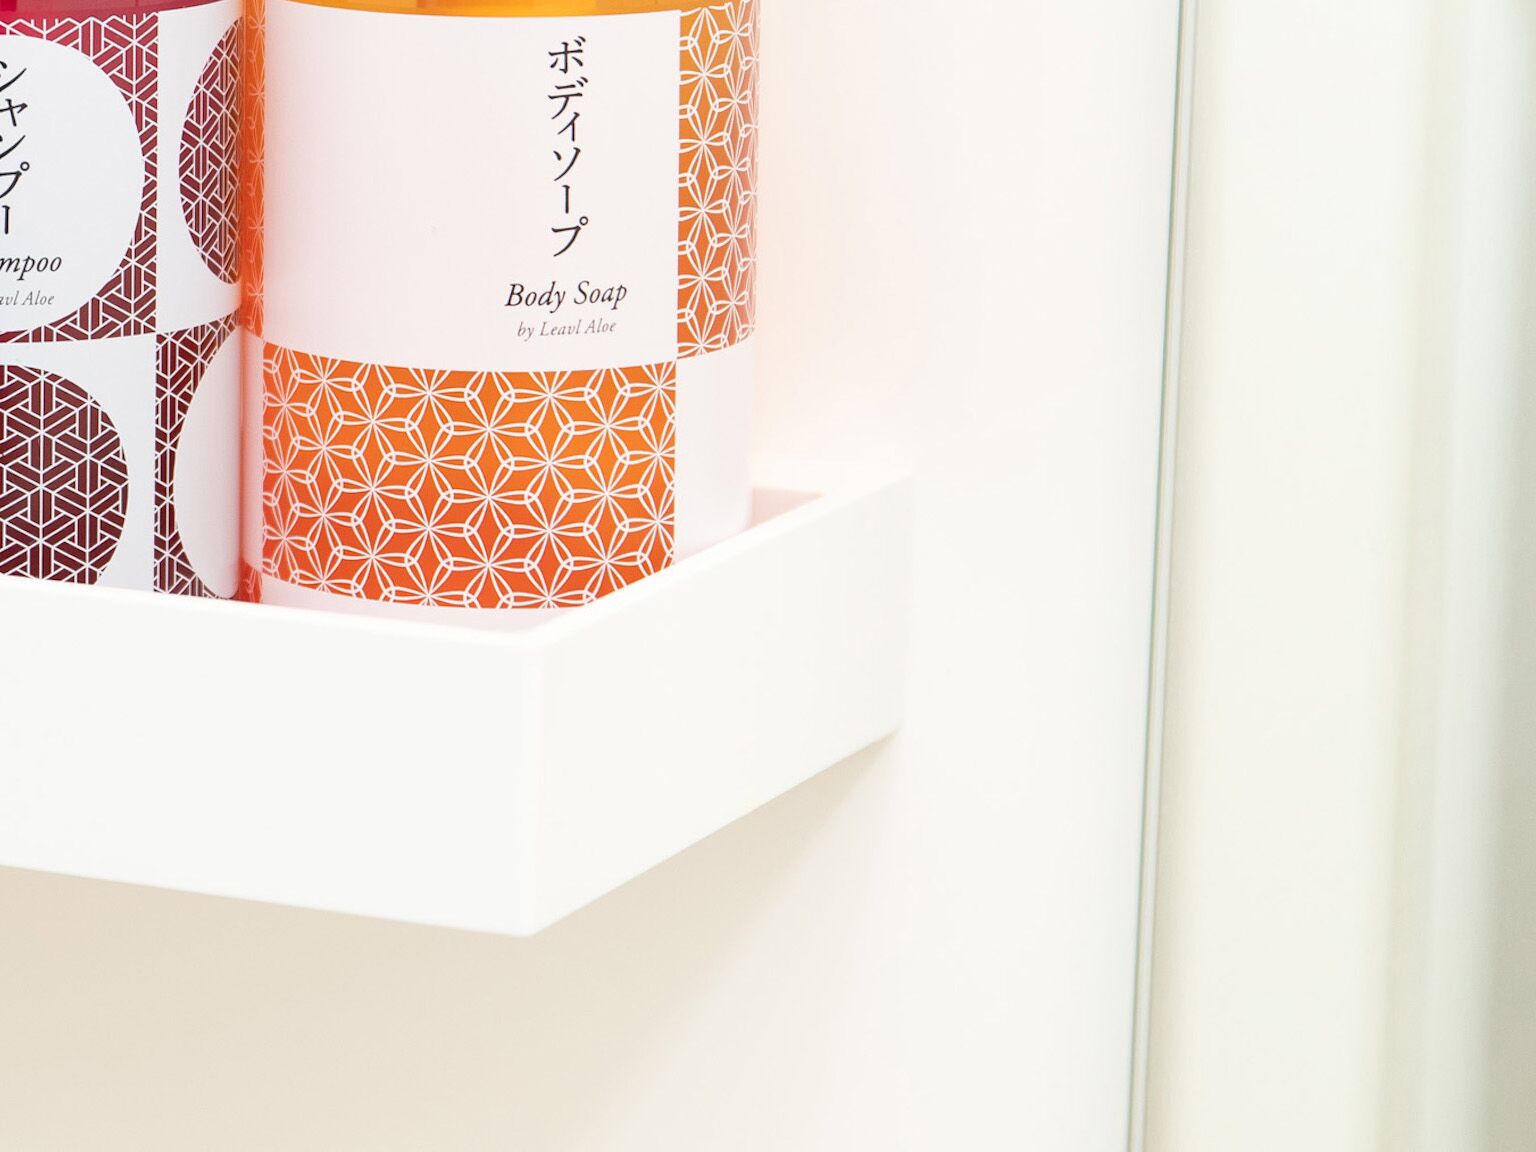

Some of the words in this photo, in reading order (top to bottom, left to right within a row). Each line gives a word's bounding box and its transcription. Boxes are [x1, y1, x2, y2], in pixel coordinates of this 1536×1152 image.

[547, 35, 589, 258] ボディソープ
[21, 289, 55, 306] Aloe
[504, 280, 567, 314] Body
[573, 280, 628, 311] Soap
[517, 321, 535, 342] by
[539, 319, 582, 337] Leavl
[584, 317, 617, 335] Aloe
